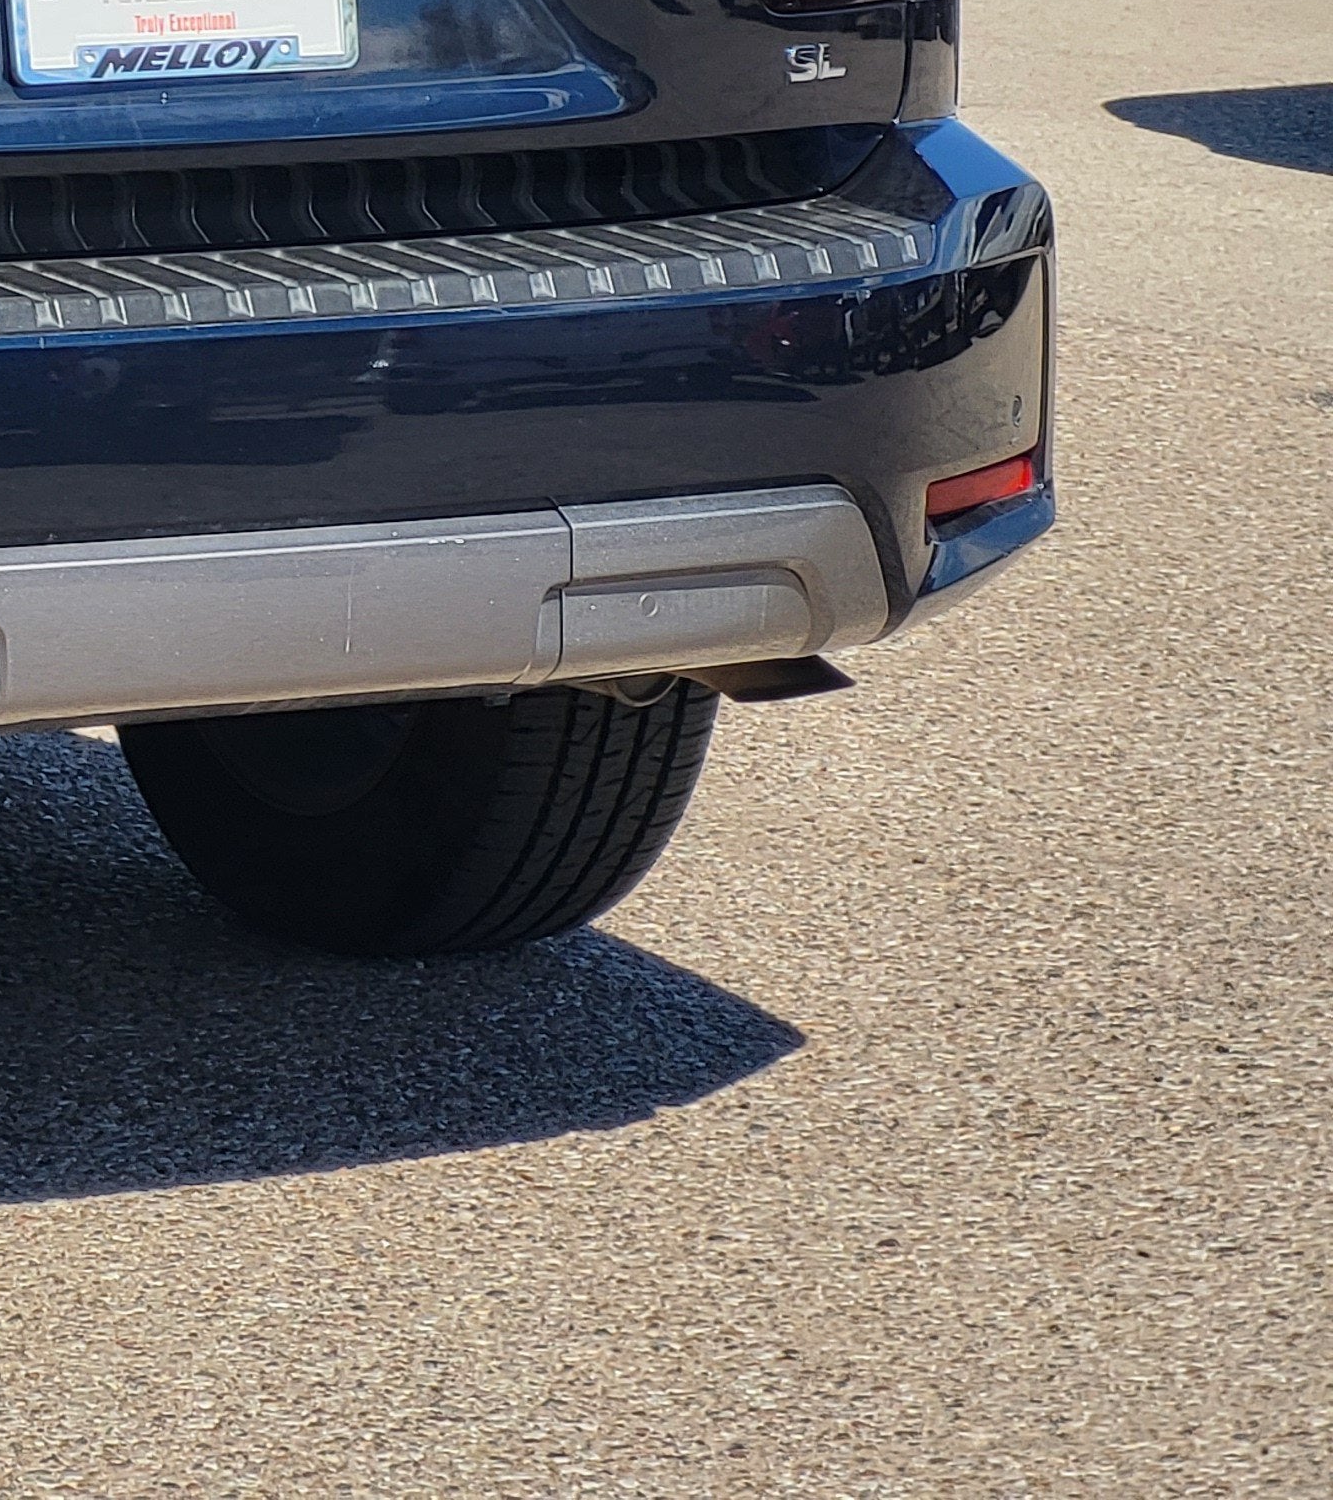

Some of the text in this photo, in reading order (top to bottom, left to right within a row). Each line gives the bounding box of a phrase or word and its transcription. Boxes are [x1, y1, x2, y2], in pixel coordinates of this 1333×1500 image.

[135, 11, 237, 36] Truly Exceptional
[91, 39, 276, 78] MELLOY
[785, 43, 847, 82] SL
